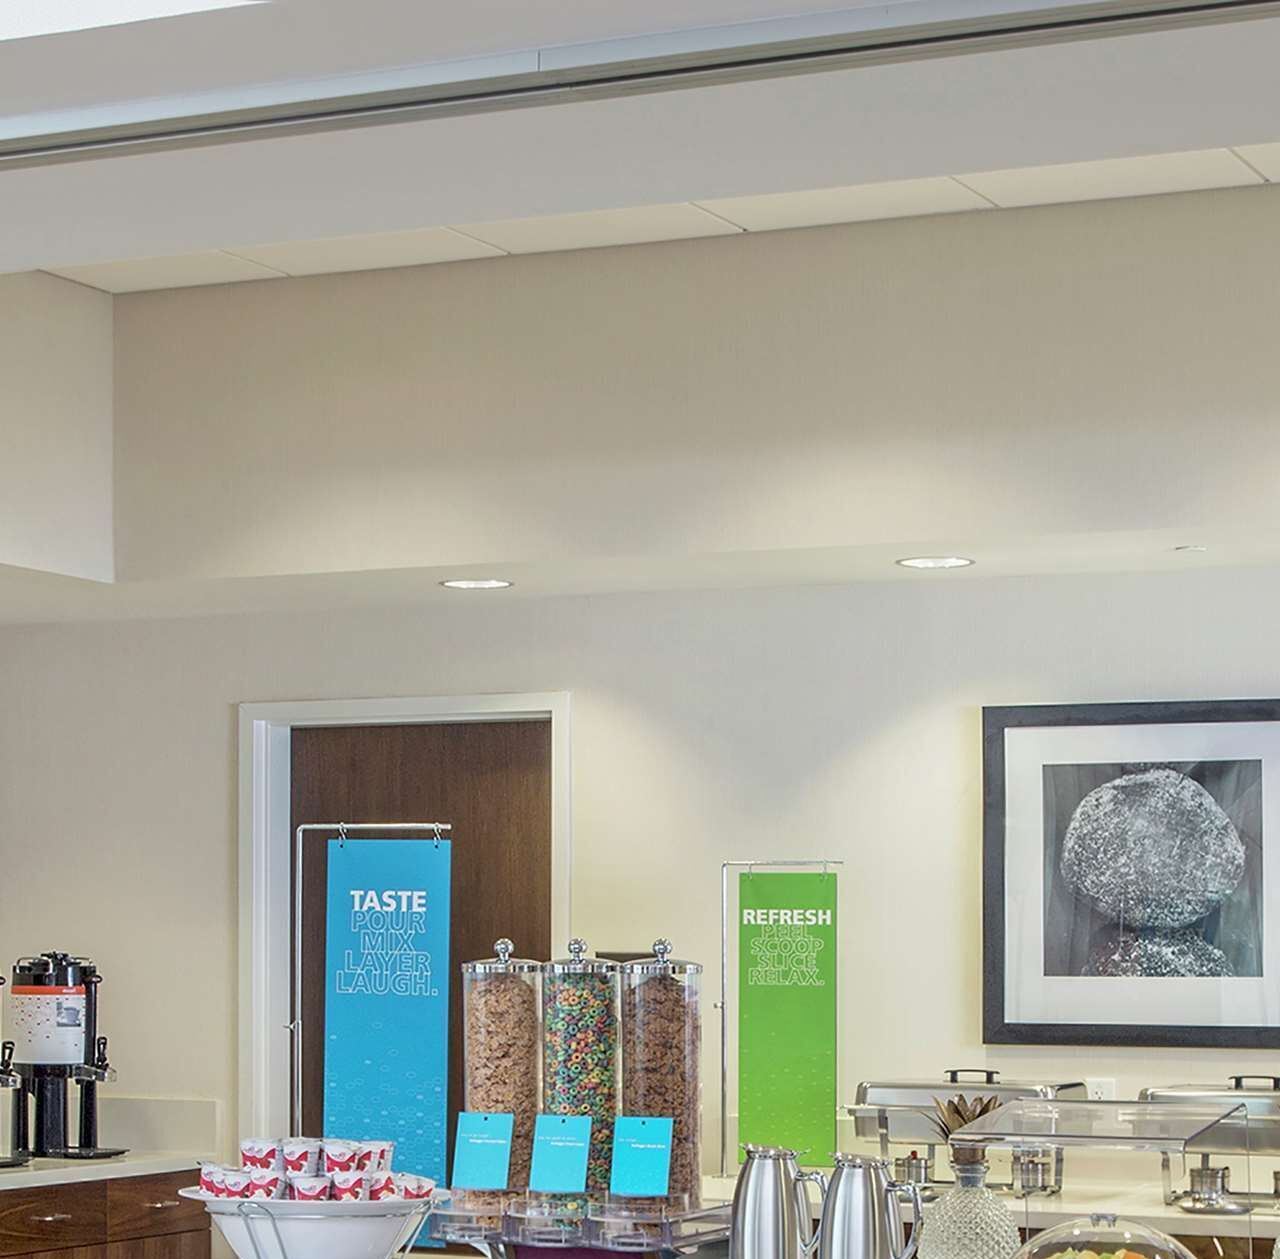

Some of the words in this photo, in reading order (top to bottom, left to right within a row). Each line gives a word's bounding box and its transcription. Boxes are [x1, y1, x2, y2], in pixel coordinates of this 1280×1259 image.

[349, 890, 427, 912] TASTE
[351, 909, 426, 933] POUR
[743, 908, 832, 925] REFRESH
[361, 930, 416, 953] MIX
[761, 923, 812, 940] PEEL
[750, 936, 824, 955] SCOOP
[344, 950, 431, 975] LAYER
[757, 952, 817, 970] SLICE
[336, 970, 439, 996] LAUGH.
[748, 967, 826, 986] RELAX.
